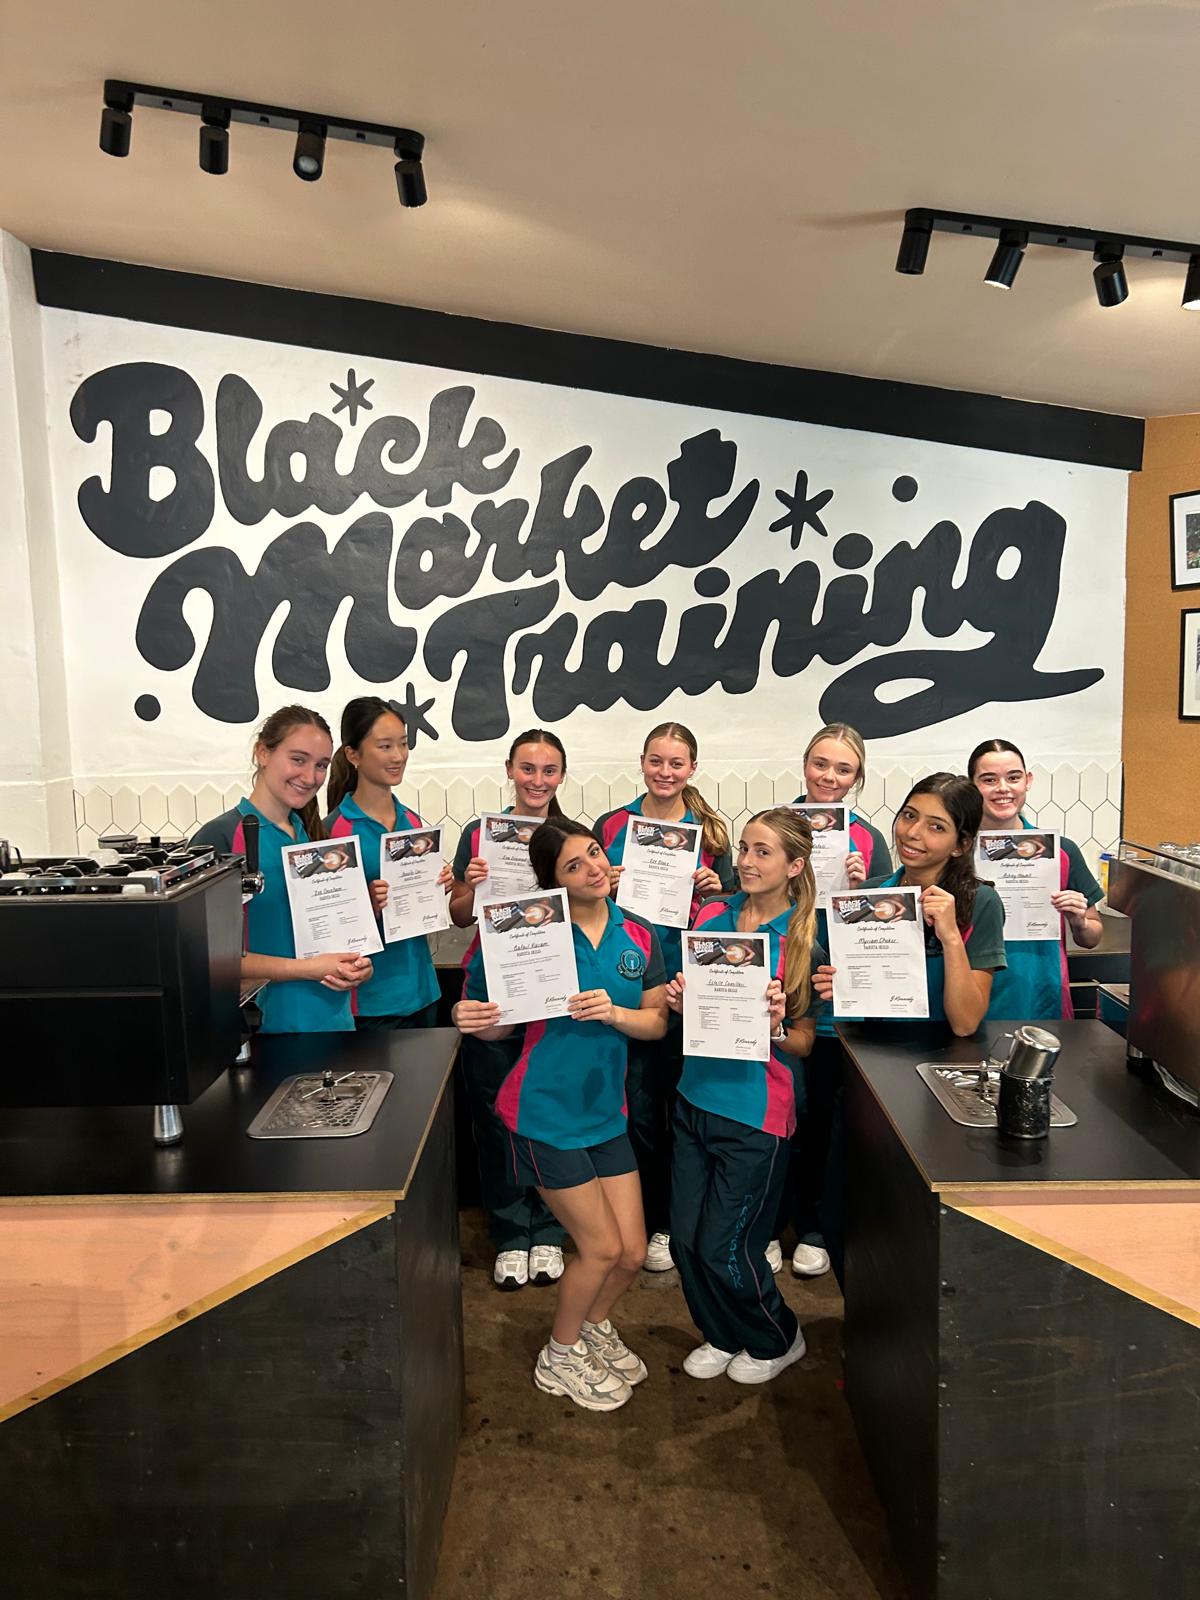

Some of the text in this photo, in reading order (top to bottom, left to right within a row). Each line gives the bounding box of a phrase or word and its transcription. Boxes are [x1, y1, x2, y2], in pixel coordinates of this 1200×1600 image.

[70, 361, 520, 558] Black
[135, 427, 760, 724] Market
[423, 500, 1105, 741] Training
